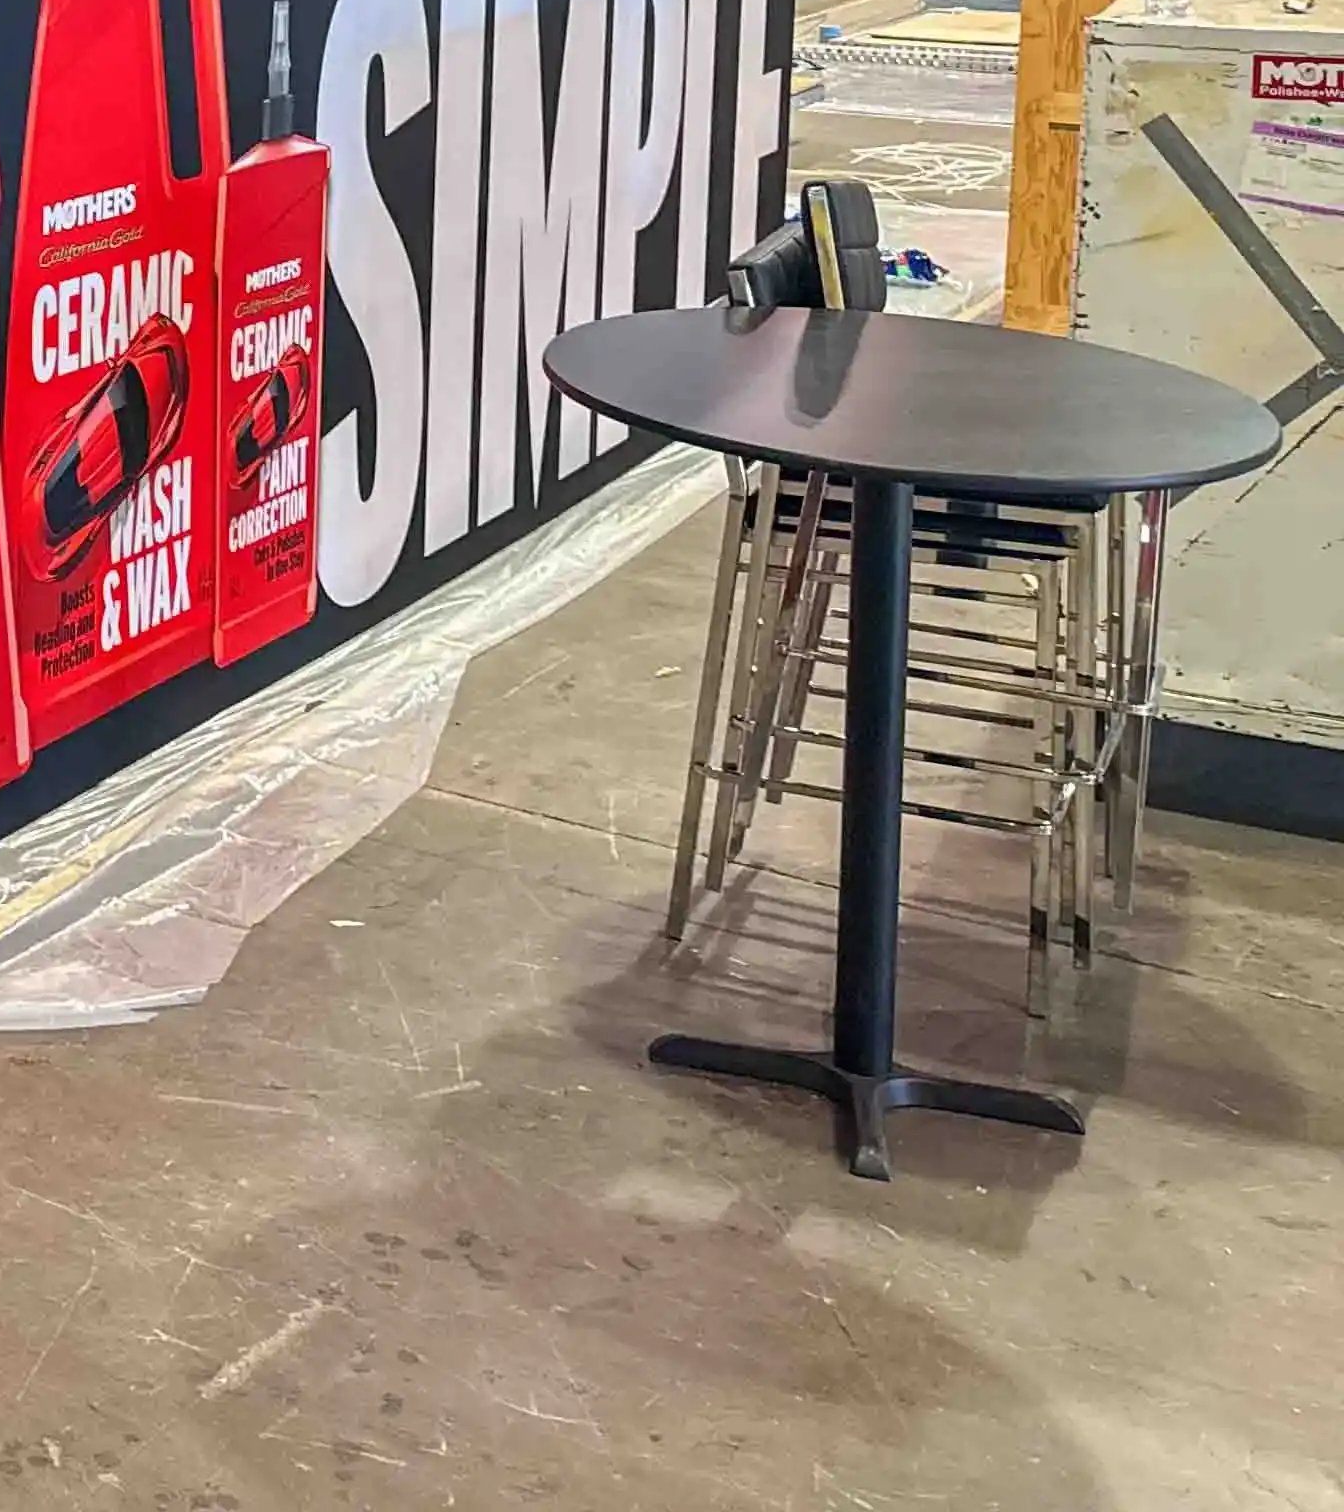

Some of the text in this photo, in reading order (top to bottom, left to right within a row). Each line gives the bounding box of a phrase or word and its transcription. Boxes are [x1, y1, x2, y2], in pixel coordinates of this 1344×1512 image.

[1260, 60, 1344, 89] MOT
[41, 182, 138, 236] MOTHERS
[245, 258, 302, 295] MOTHERS
[31, 248, 195, 384] CERAMIC
[229, 303, 313, 383] CERAMIC
[259, 435, 310, 503] PAINT
[109, 455, 193, 565] WASH
[228, 485, 308, 554] CORRECTION
[100, 568, 123, 653] &
[126, 534, 193, 639] WAX
[41, 639, 97, 681] Protection
